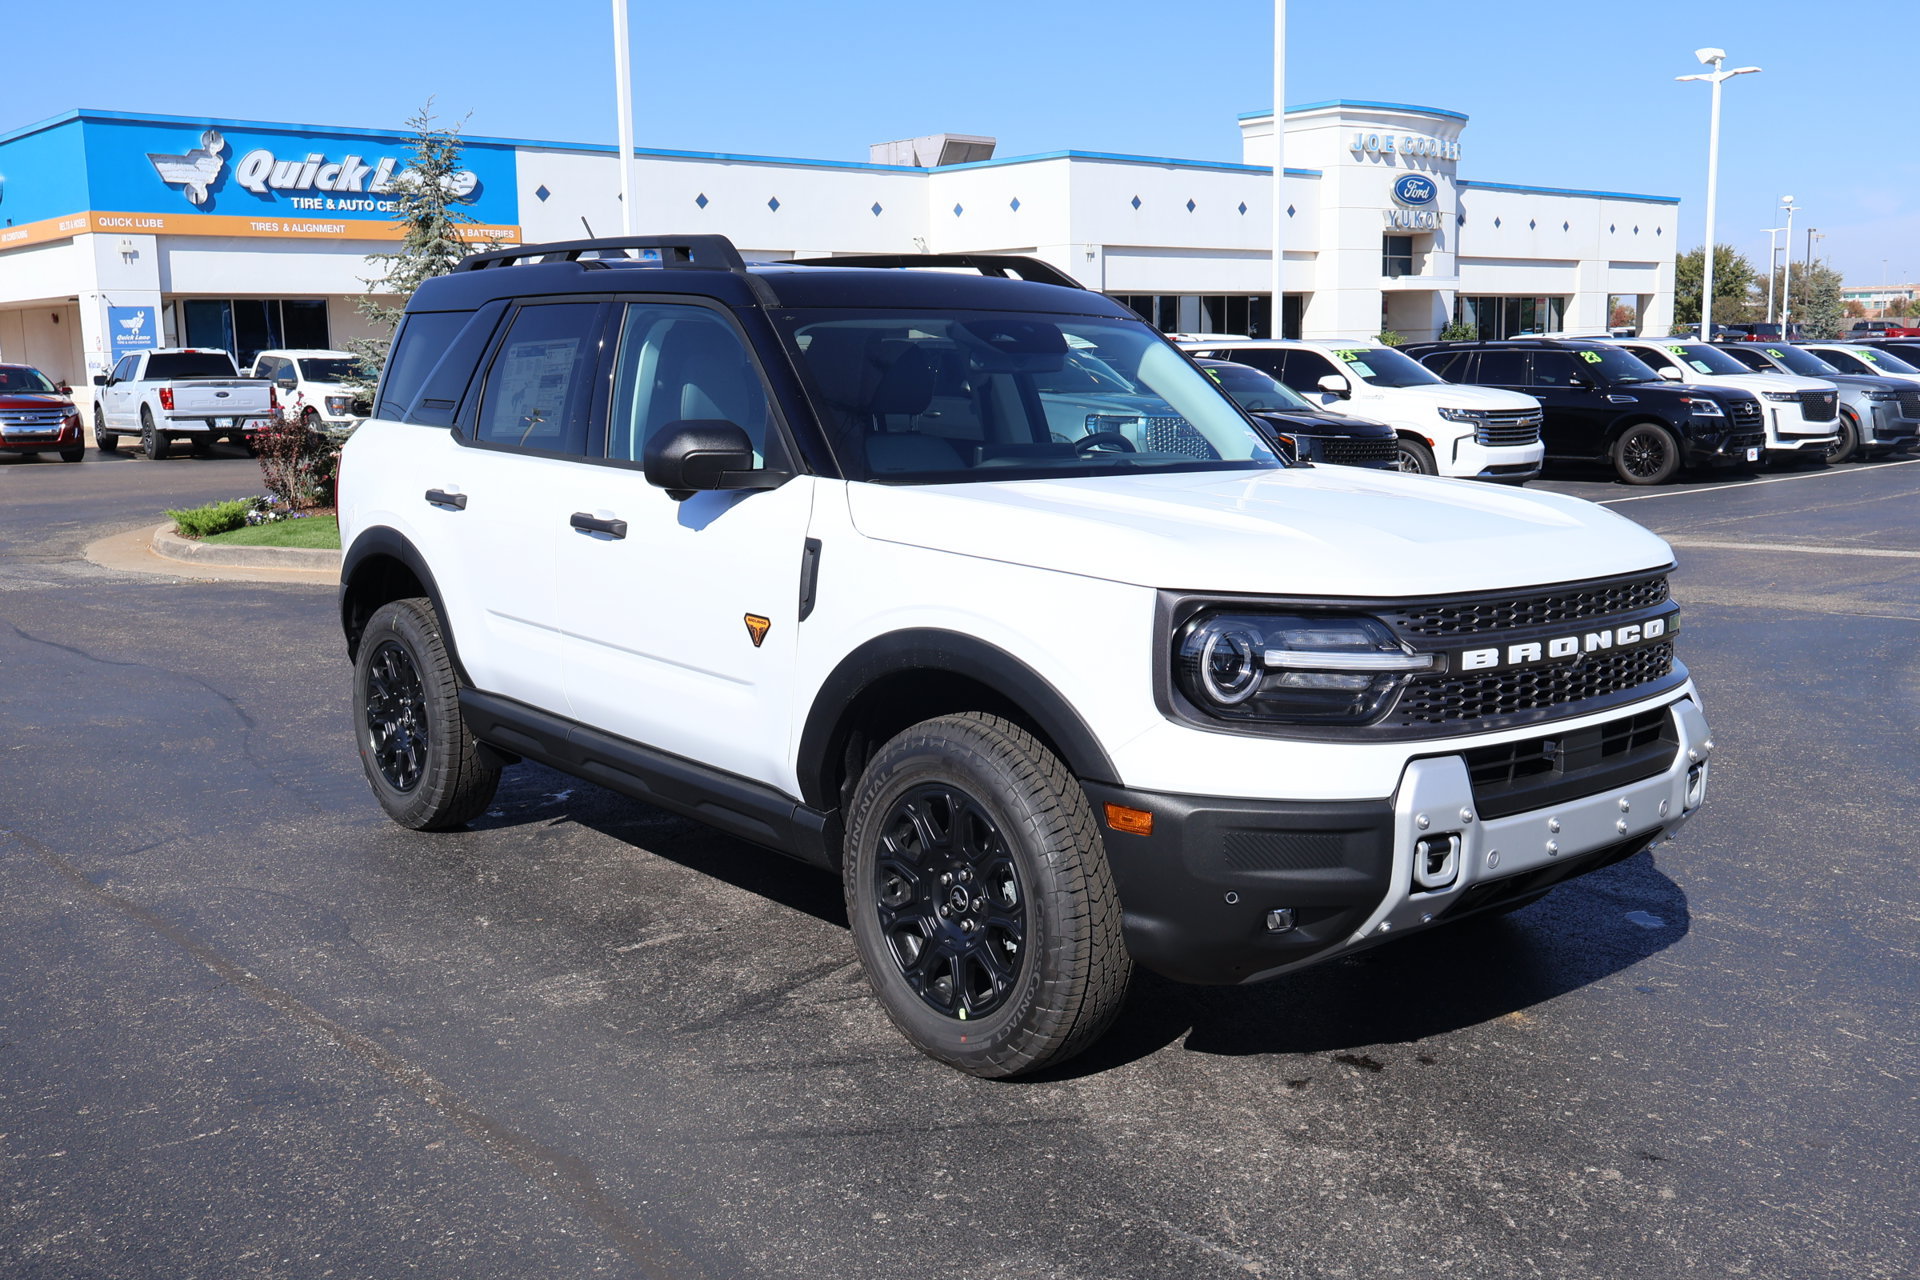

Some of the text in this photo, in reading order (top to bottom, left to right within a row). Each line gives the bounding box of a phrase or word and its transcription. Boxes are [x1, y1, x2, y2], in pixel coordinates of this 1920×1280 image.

[1351, 132, 1461, 160] JOE COOPER
[236, 148, 373, 193] Quick
[1403, 179, 1431, 200] Ford
[291, 197, 323, 210] TIRE
[327, 198, 336, 211] &
[337, 199, 374, 212] AUTO
[98, 216, 164, 228] QUICK LUBE
[250, 221, 346, 234] TIRES & ALIGNMENT
[1386, 210, 1442, 229] YUKON
[467, 228, 515, 239] BATTERIES
[1579, 350, 1603, 364] 23
[1462, 618, 1665, 671] BRONCO
[850, 771, 892, 910] CONTINENTAL
